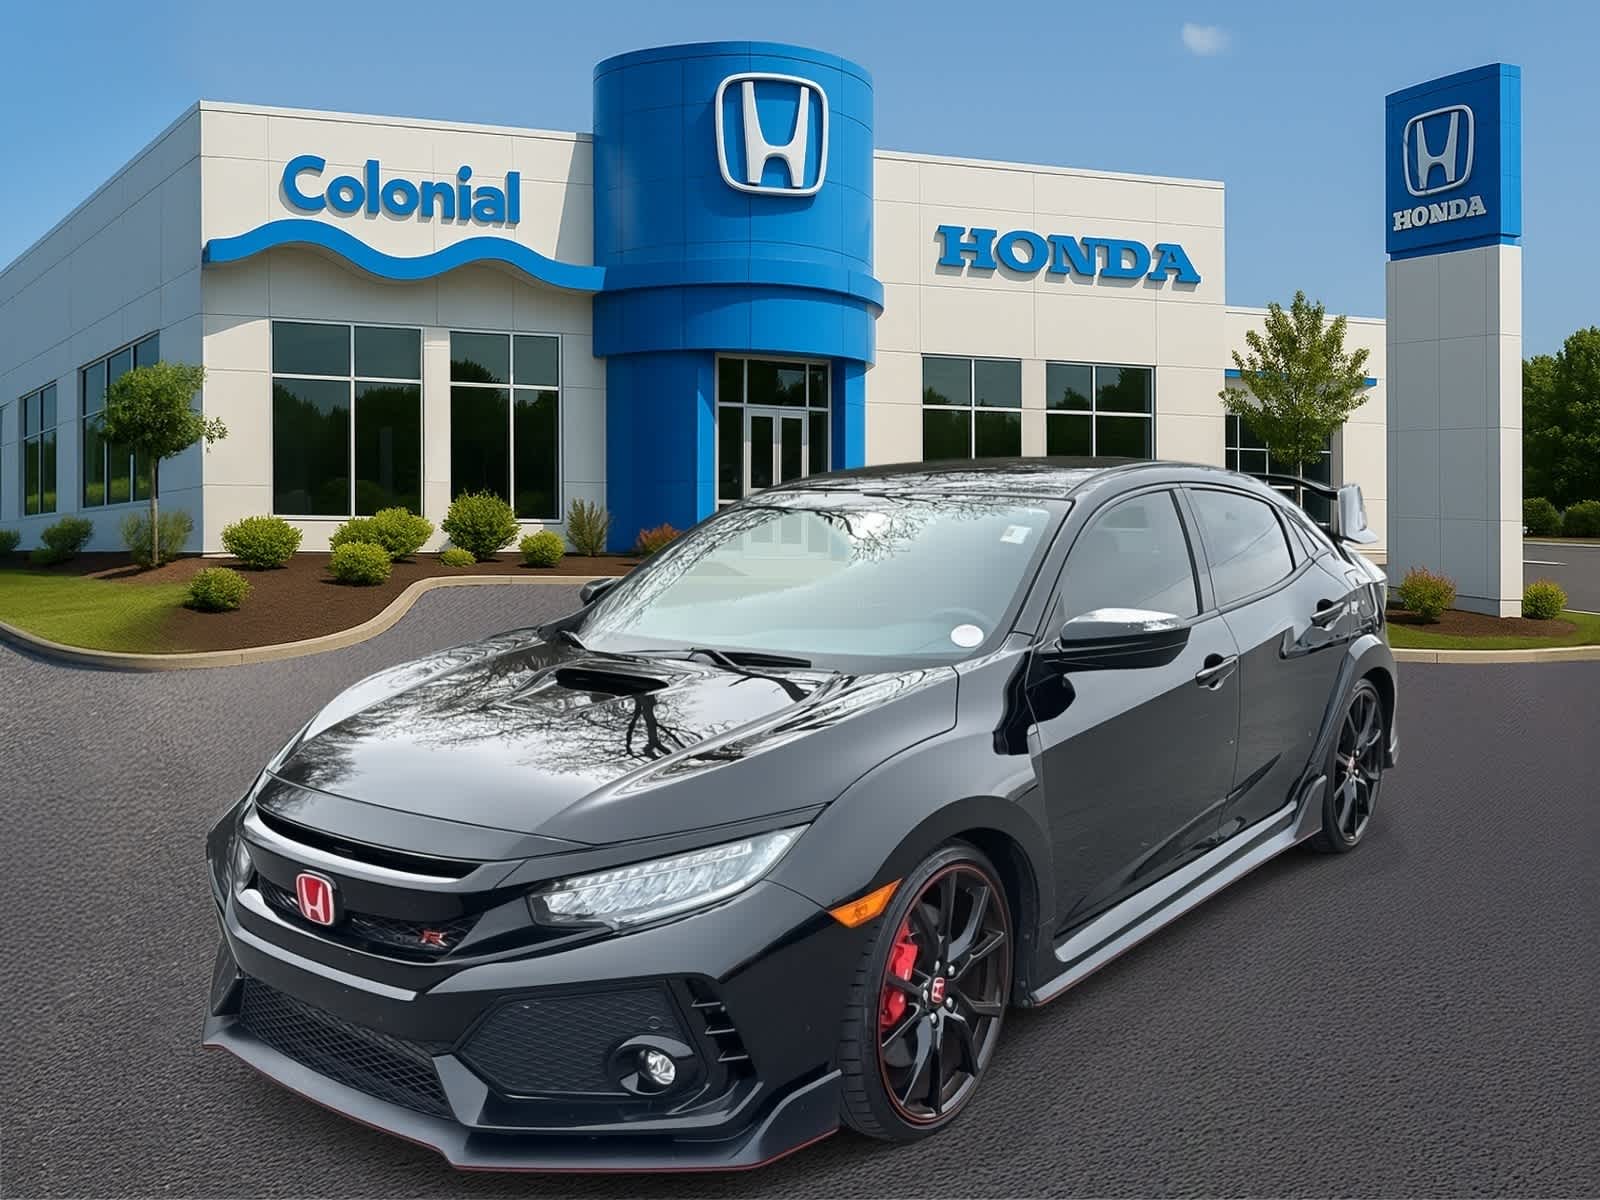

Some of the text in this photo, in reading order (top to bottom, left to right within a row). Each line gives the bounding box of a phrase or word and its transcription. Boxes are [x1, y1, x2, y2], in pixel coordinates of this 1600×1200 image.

[282, 154, 521, 225] Colonial
[1393, 195, 1487, 232] HONDA
[937, 225, 1201, 284] HONDA
